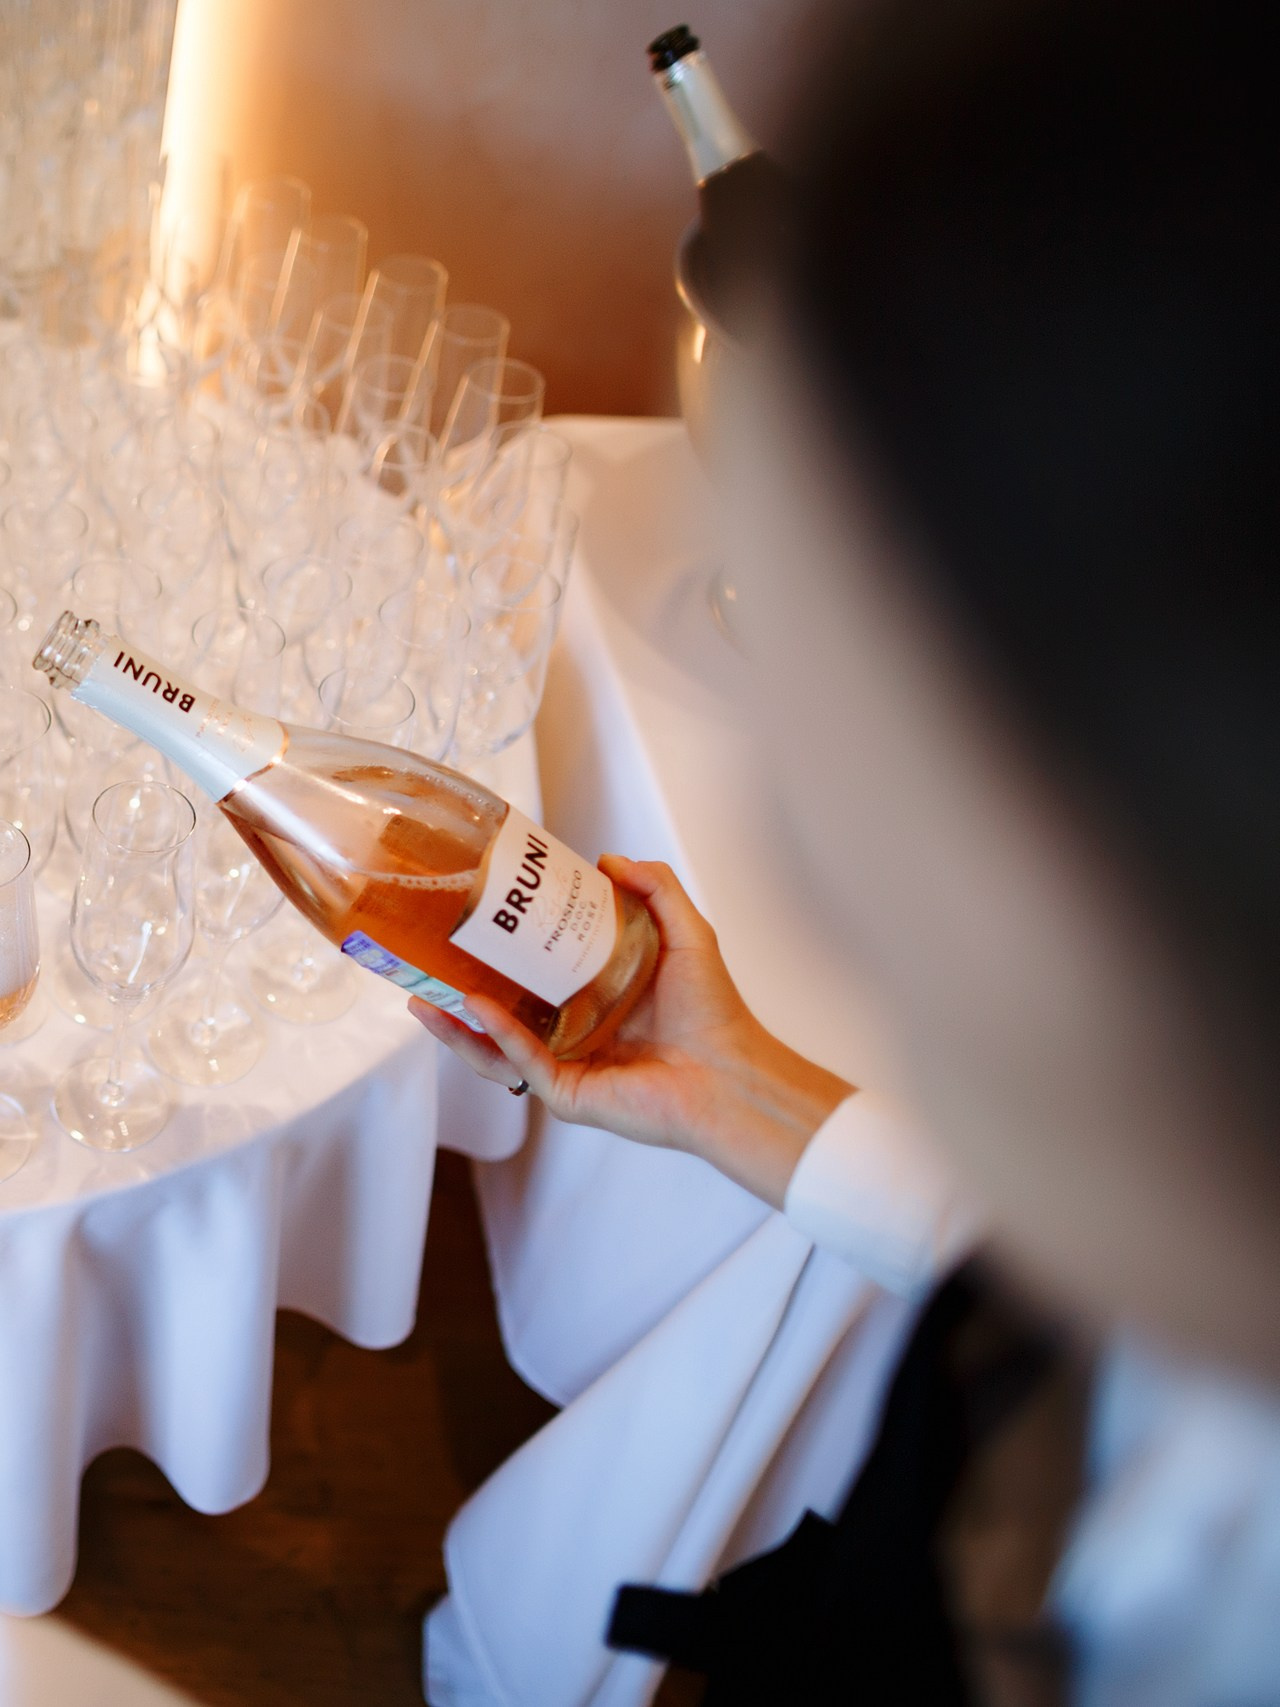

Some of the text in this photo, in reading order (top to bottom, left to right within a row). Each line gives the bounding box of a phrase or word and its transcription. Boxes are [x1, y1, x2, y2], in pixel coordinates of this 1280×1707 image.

[113, 651, 196, 714] BRUNI
[492, 833, 549, 935] BRUNI
[543, 870, 583, 953] PROSECCO
[570, 901, 588, 932] DOC
